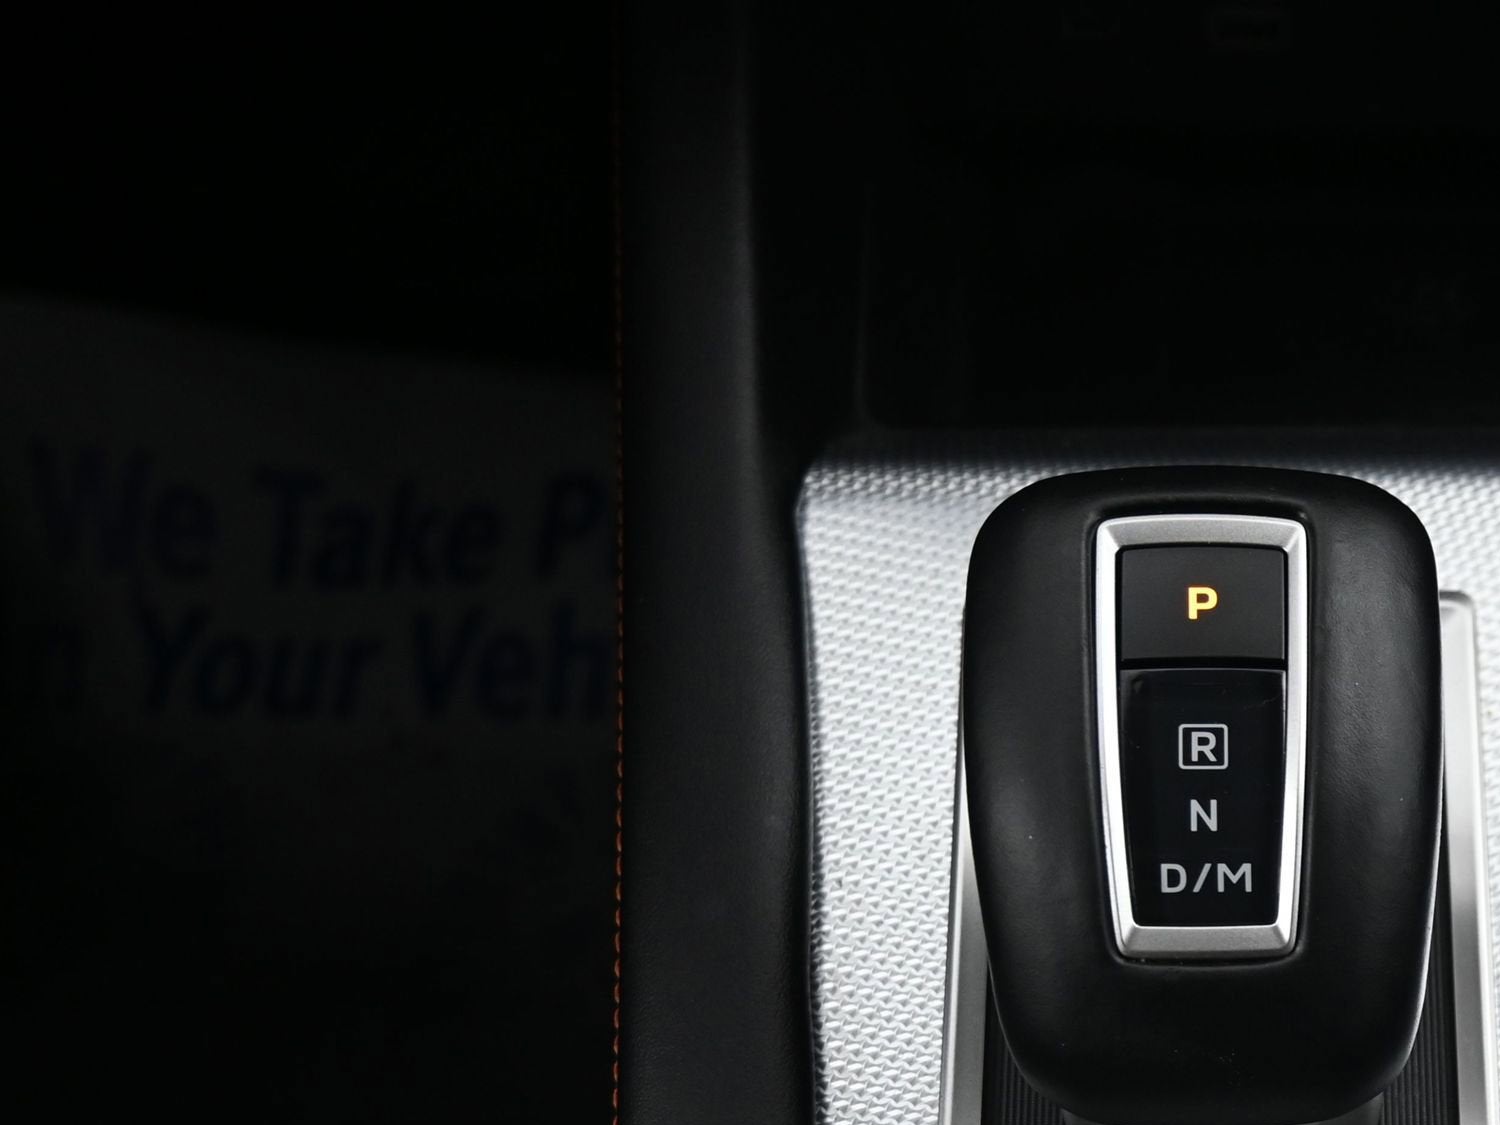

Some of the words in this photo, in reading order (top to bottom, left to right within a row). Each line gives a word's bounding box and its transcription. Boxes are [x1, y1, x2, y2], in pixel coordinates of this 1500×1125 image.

[27, 430, 222, 580] We
[253, 462, 506, 594] Take
[1187, 586, 1218, 620] P
[128, 588, 388, 722] Your
[1190, 731, 1217, 762] R
[1190, 799, 1218, 832] N
[1160, 863, 1252, 893] D/M
